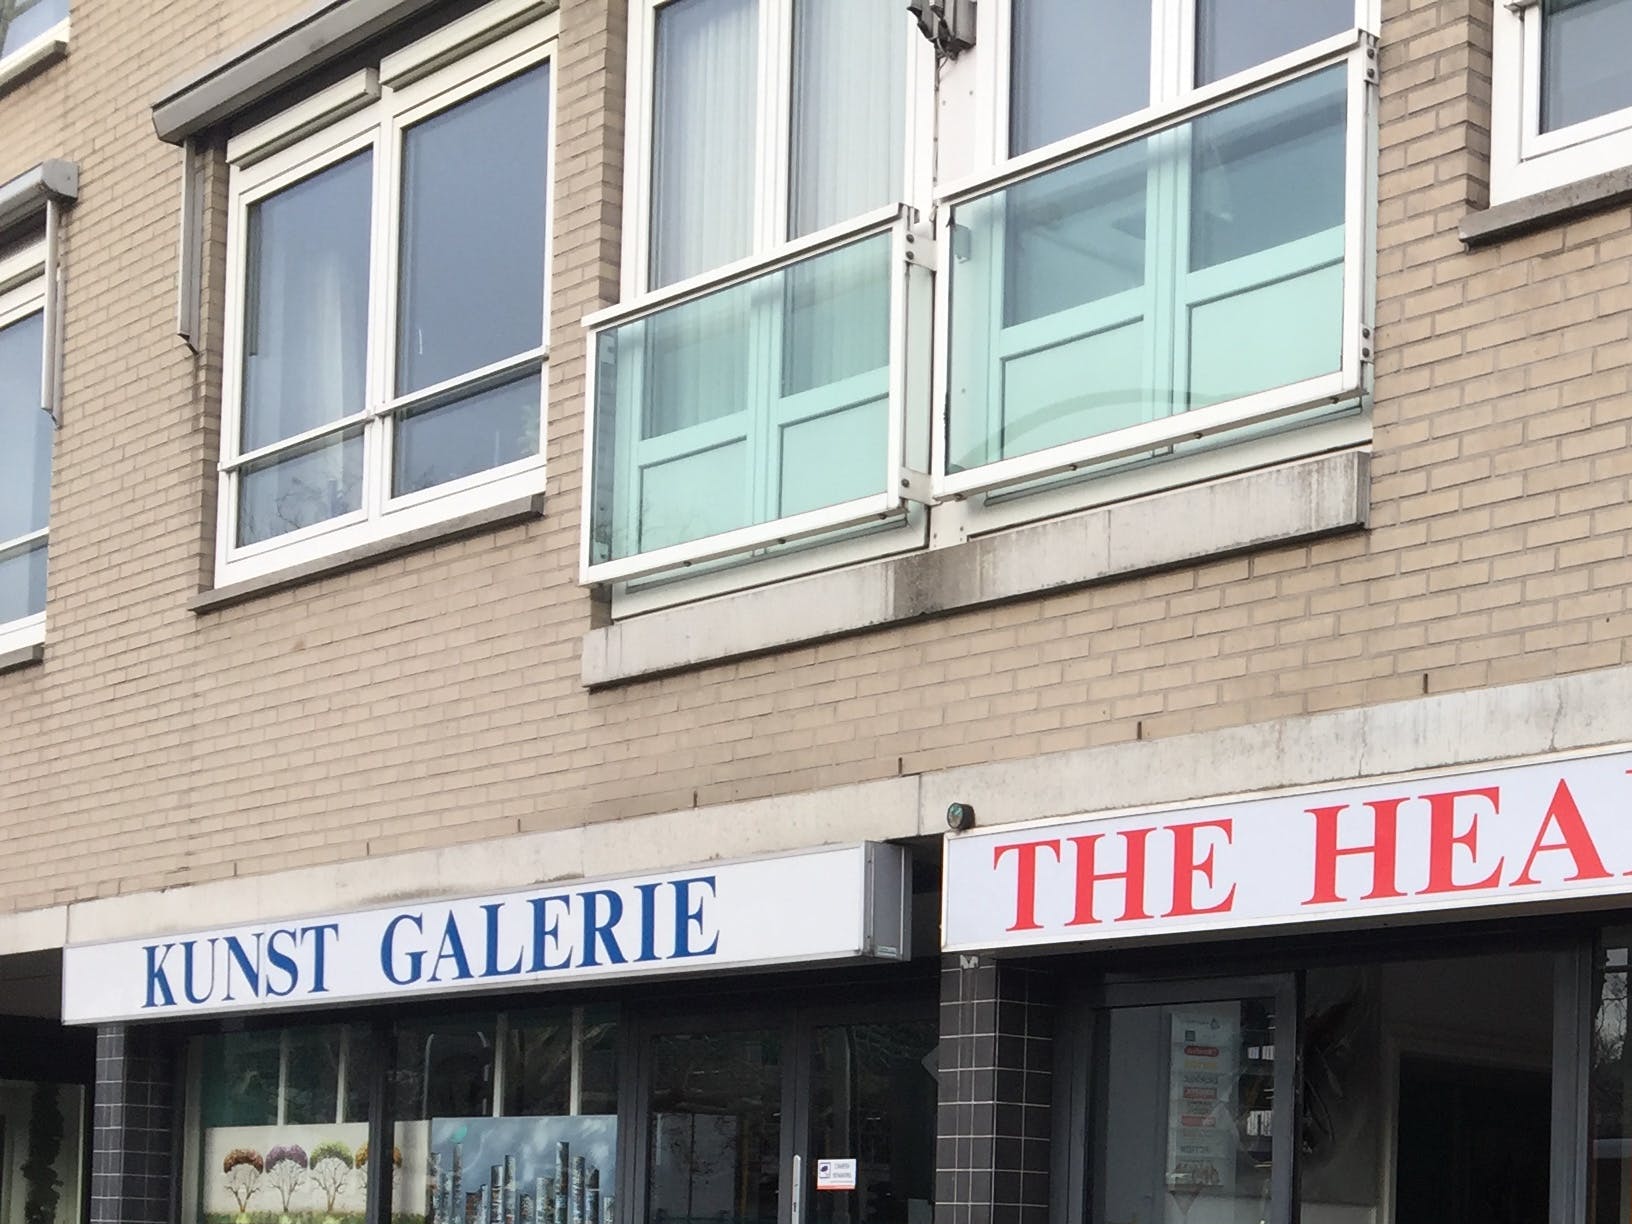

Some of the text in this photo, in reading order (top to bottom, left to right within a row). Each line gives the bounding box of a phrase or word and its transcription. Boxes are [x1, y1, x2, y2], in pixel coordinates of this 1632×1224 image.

[994, 818, 1237, 931] THE
[143, 875, 721, 1008] KUNST GALERIE
